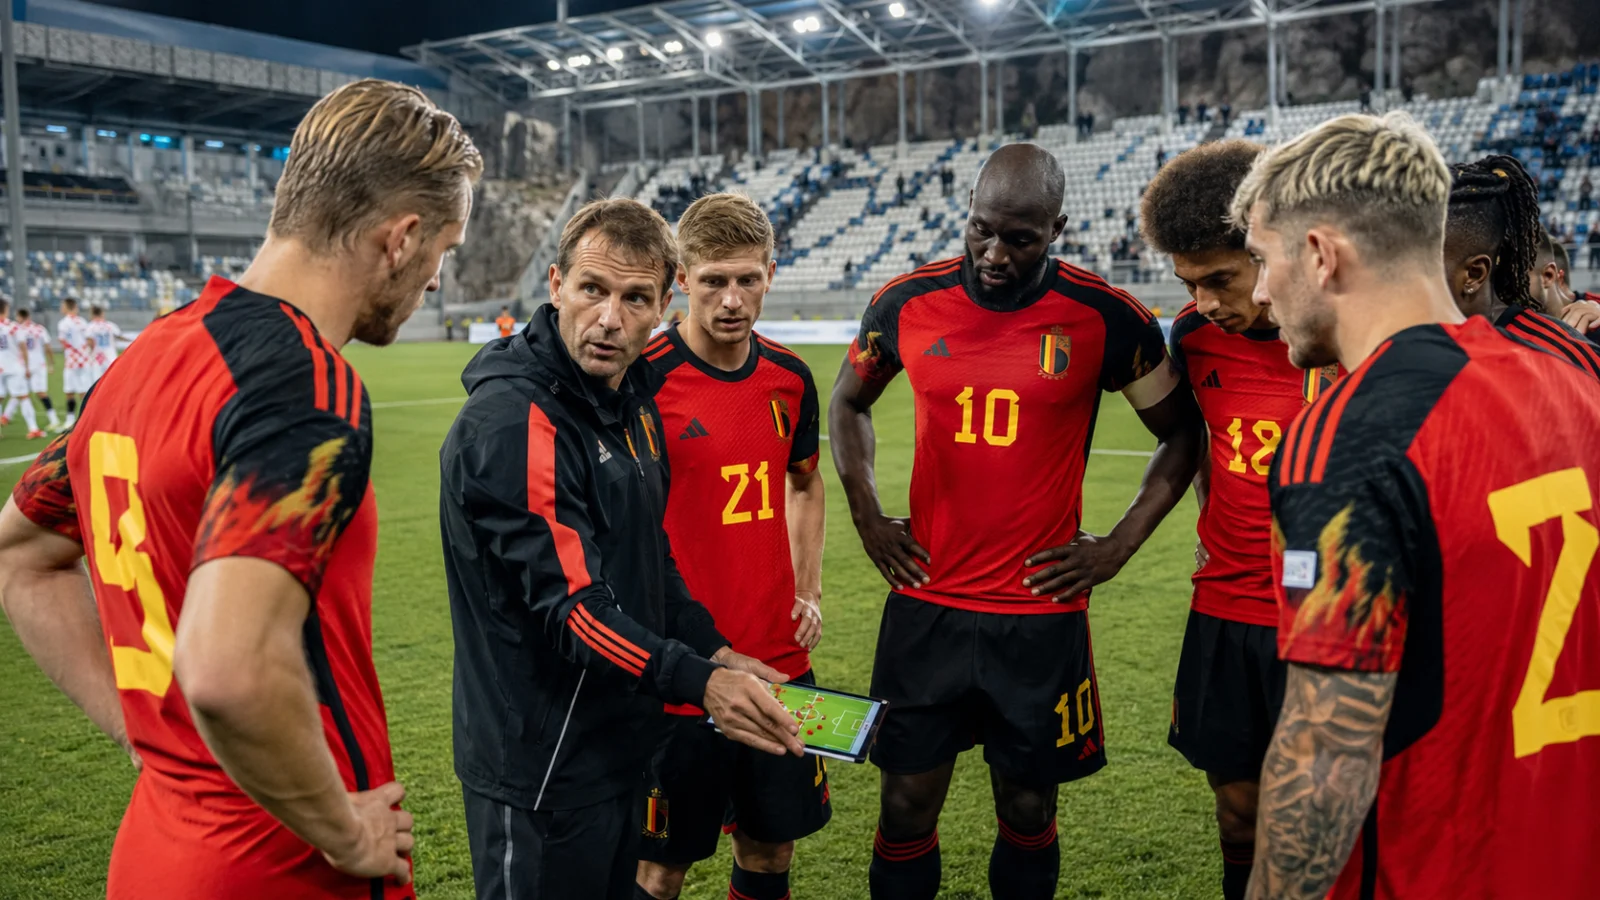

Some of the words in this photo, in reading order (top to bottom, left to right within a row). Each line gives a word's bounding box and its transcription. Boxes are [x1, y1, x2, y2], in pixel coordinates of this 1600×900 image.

[954, 386, 1020, 447] 10
[1226, 417, 1282, 476] 18
[721, 461, 774, 525] 21
[1487, 467, 1600, 759] 2
[1054, 678, 1095, 748] 10
